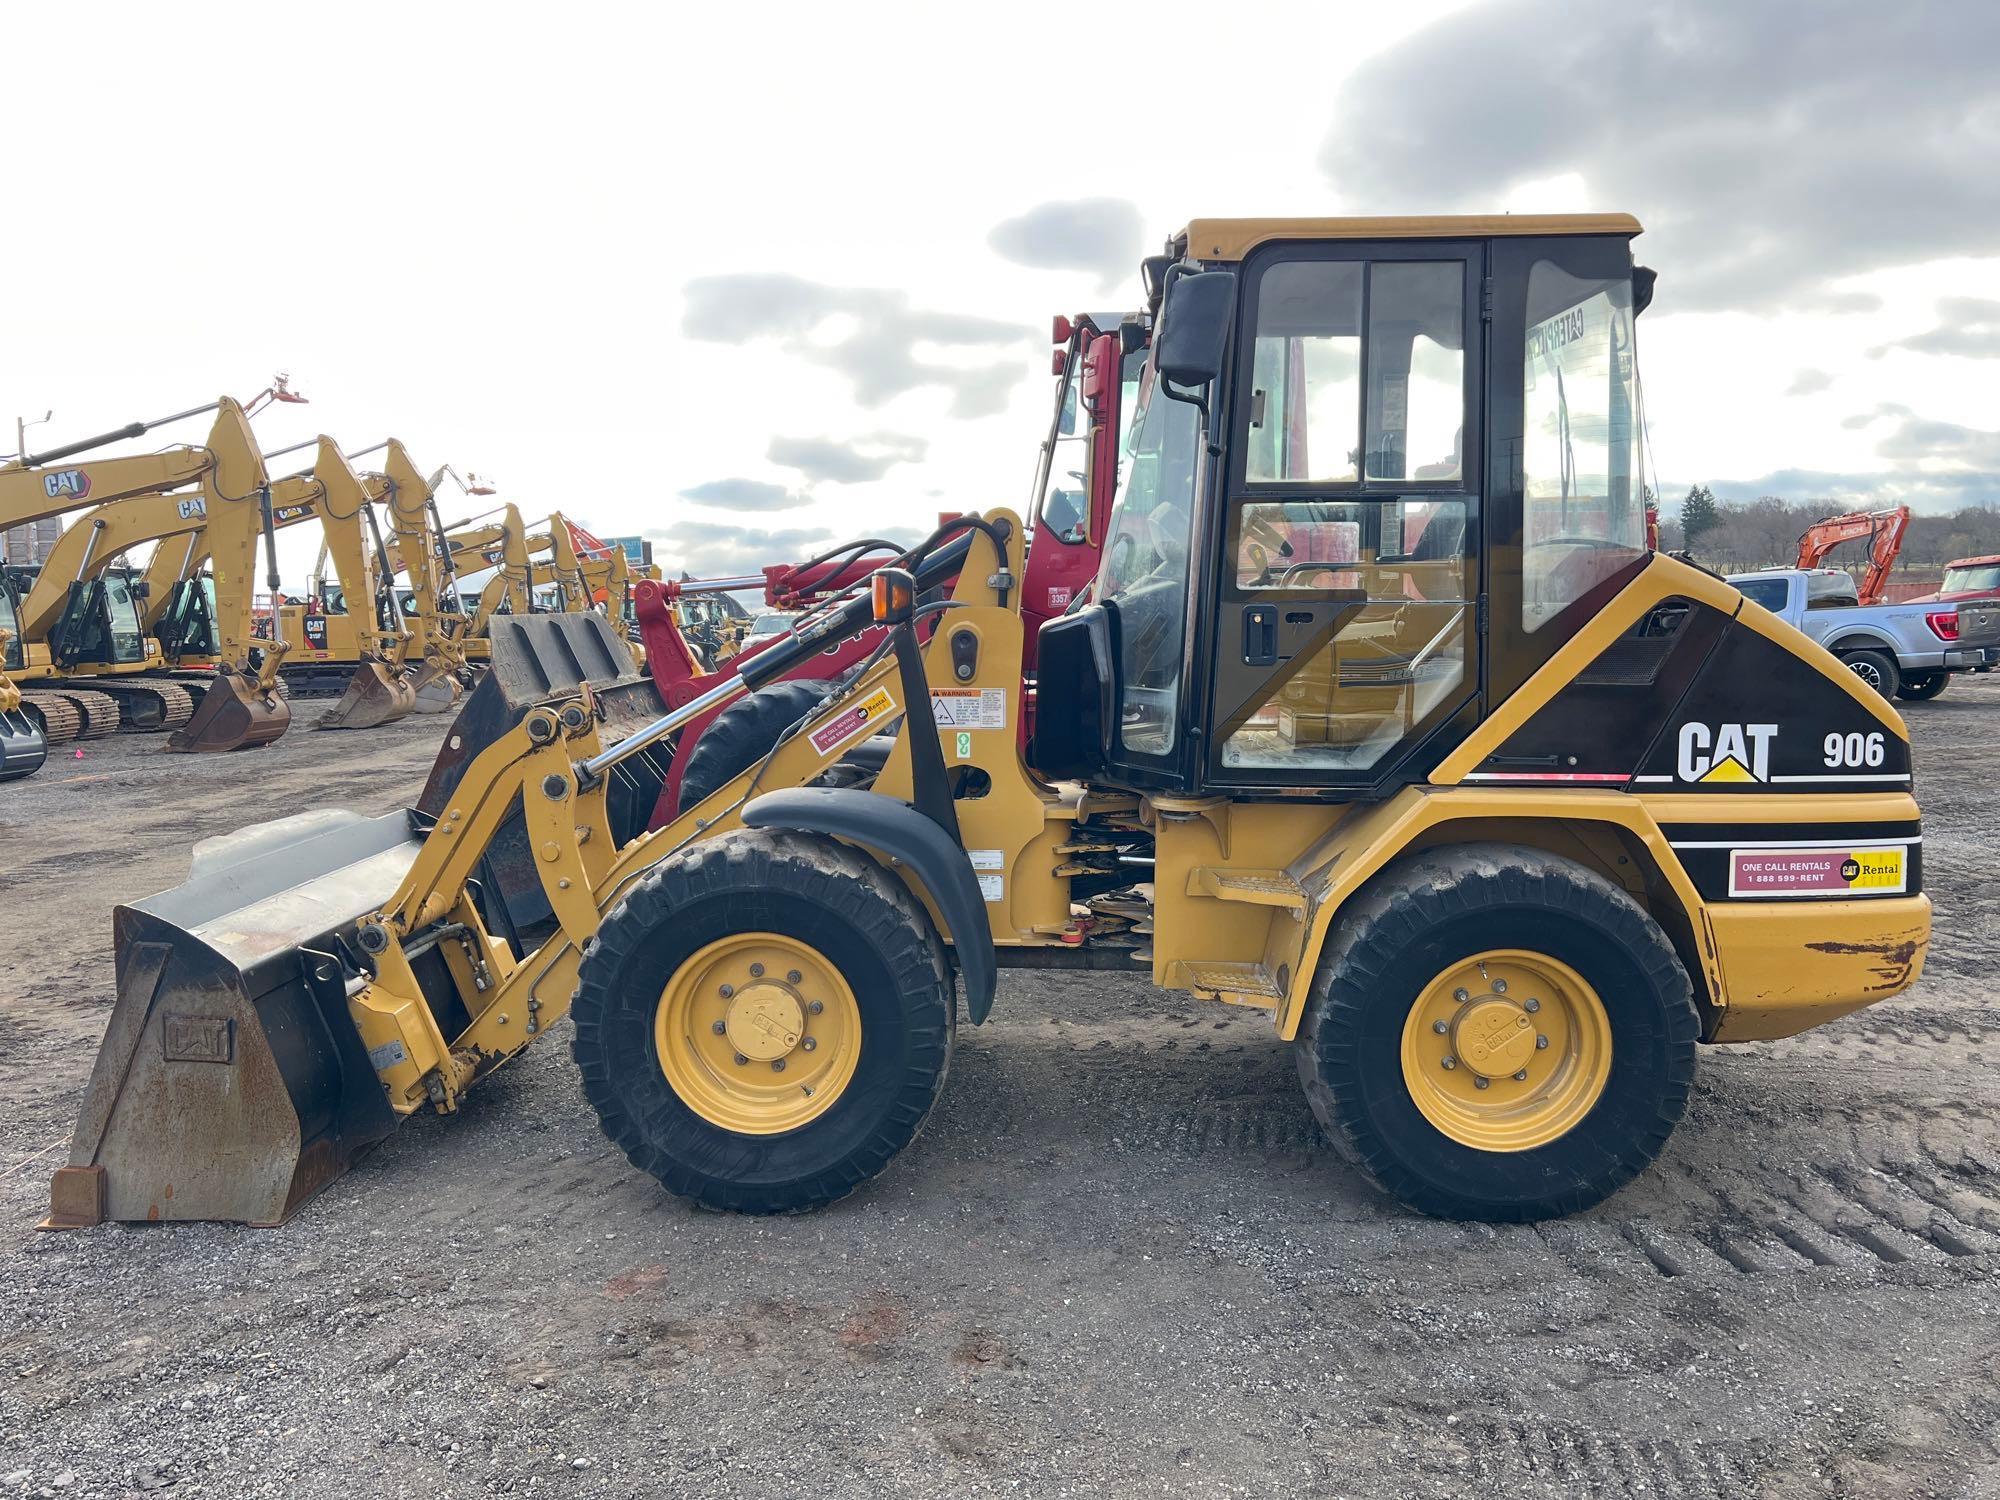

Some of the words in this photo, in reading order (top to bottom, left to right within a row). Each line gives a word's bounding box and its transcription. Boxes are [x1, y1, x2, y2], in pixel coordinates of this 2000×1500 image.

[44, 470, 79, 497] CAT
[1051, 594, 1068, 603] 3357
[307, 620, 325, 632] CAT
[1678, 722, 1778, 783] CAT
[1823, 732, 1885, 767] 906
[1742, 863, 1762, 872] ONE
[1764, 863, 1788, 871] CALL
[1790, 862, 1830, 871] RENTALS
[1842, 865, 1857, 876] CAT
[1862, 864, 1898, 875] Rental
[1756, 875, 1775, 883] 888
